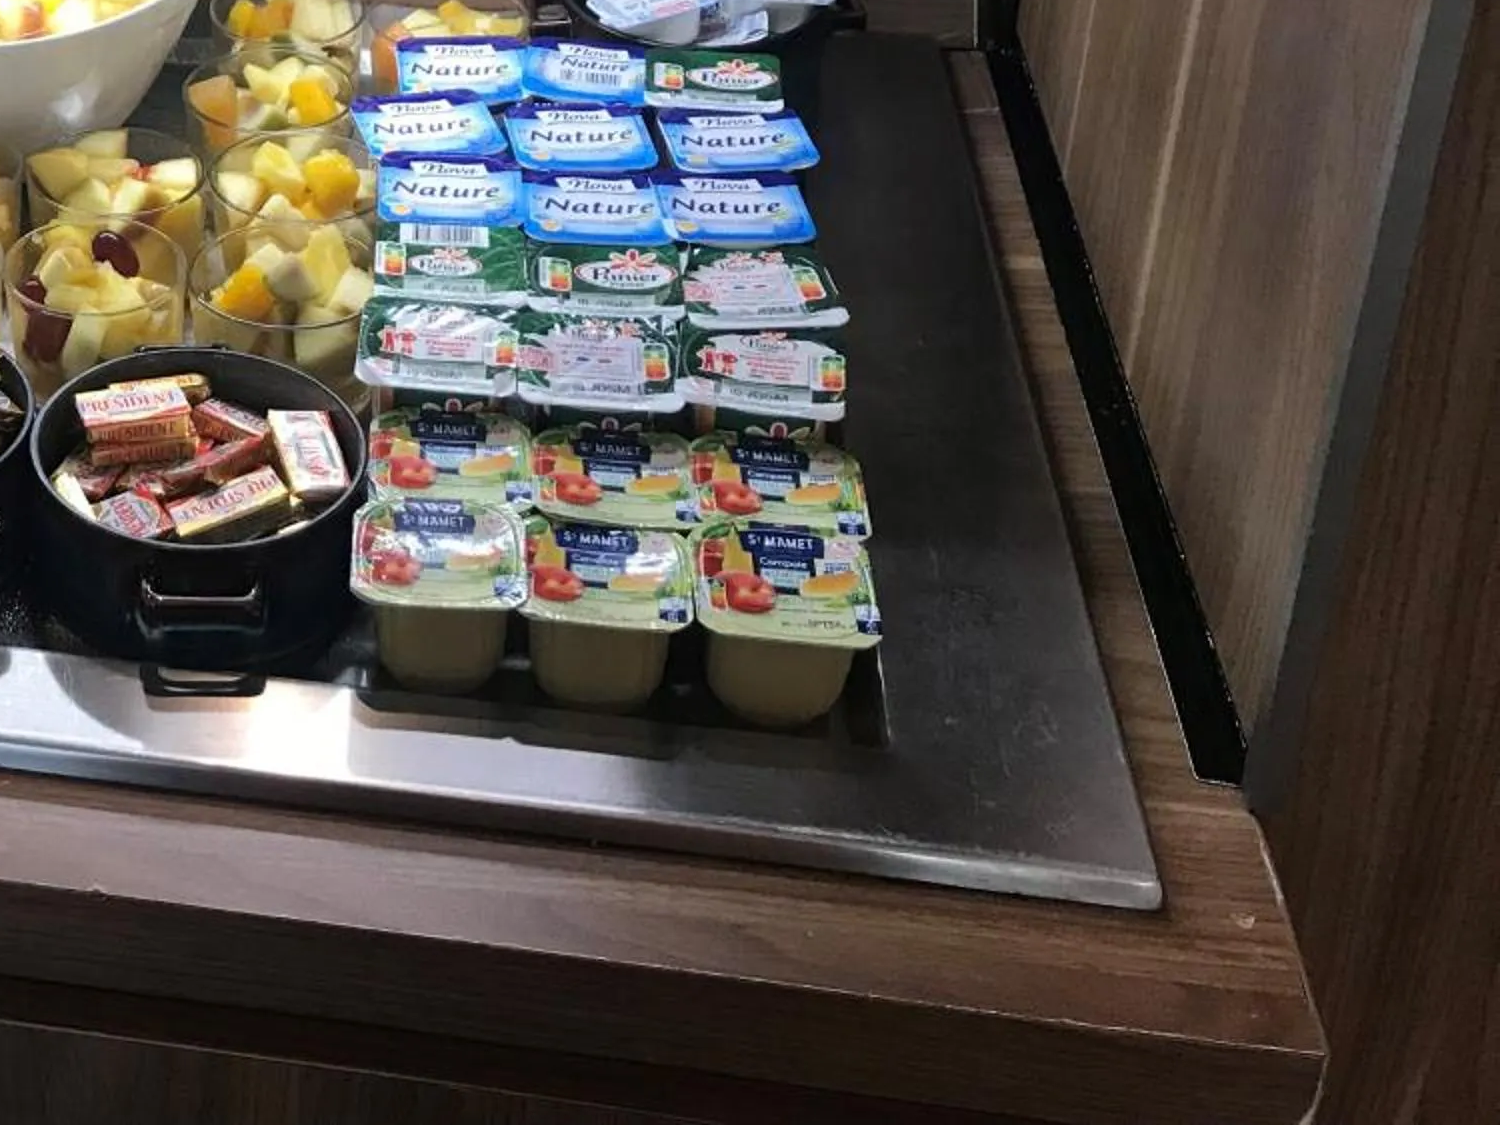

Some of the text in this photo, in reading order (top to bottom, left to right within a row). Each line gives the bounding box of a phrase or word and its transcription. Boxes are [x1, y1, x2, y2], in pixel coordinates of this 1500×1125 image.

[410, 61, 510, 77] Nature
[560, 55, 631, 72] Nature
[372, 117, 471, 136] Nature
[530, 127, 634, 143] Nature
[680, 131, 785, 148] Nature
[392, 180, 501, 199] Nature
[544, 197, 655, 216] Nature
[671, 197, 782, 215] Nature
[763, 535, 814, 550] MAMET
